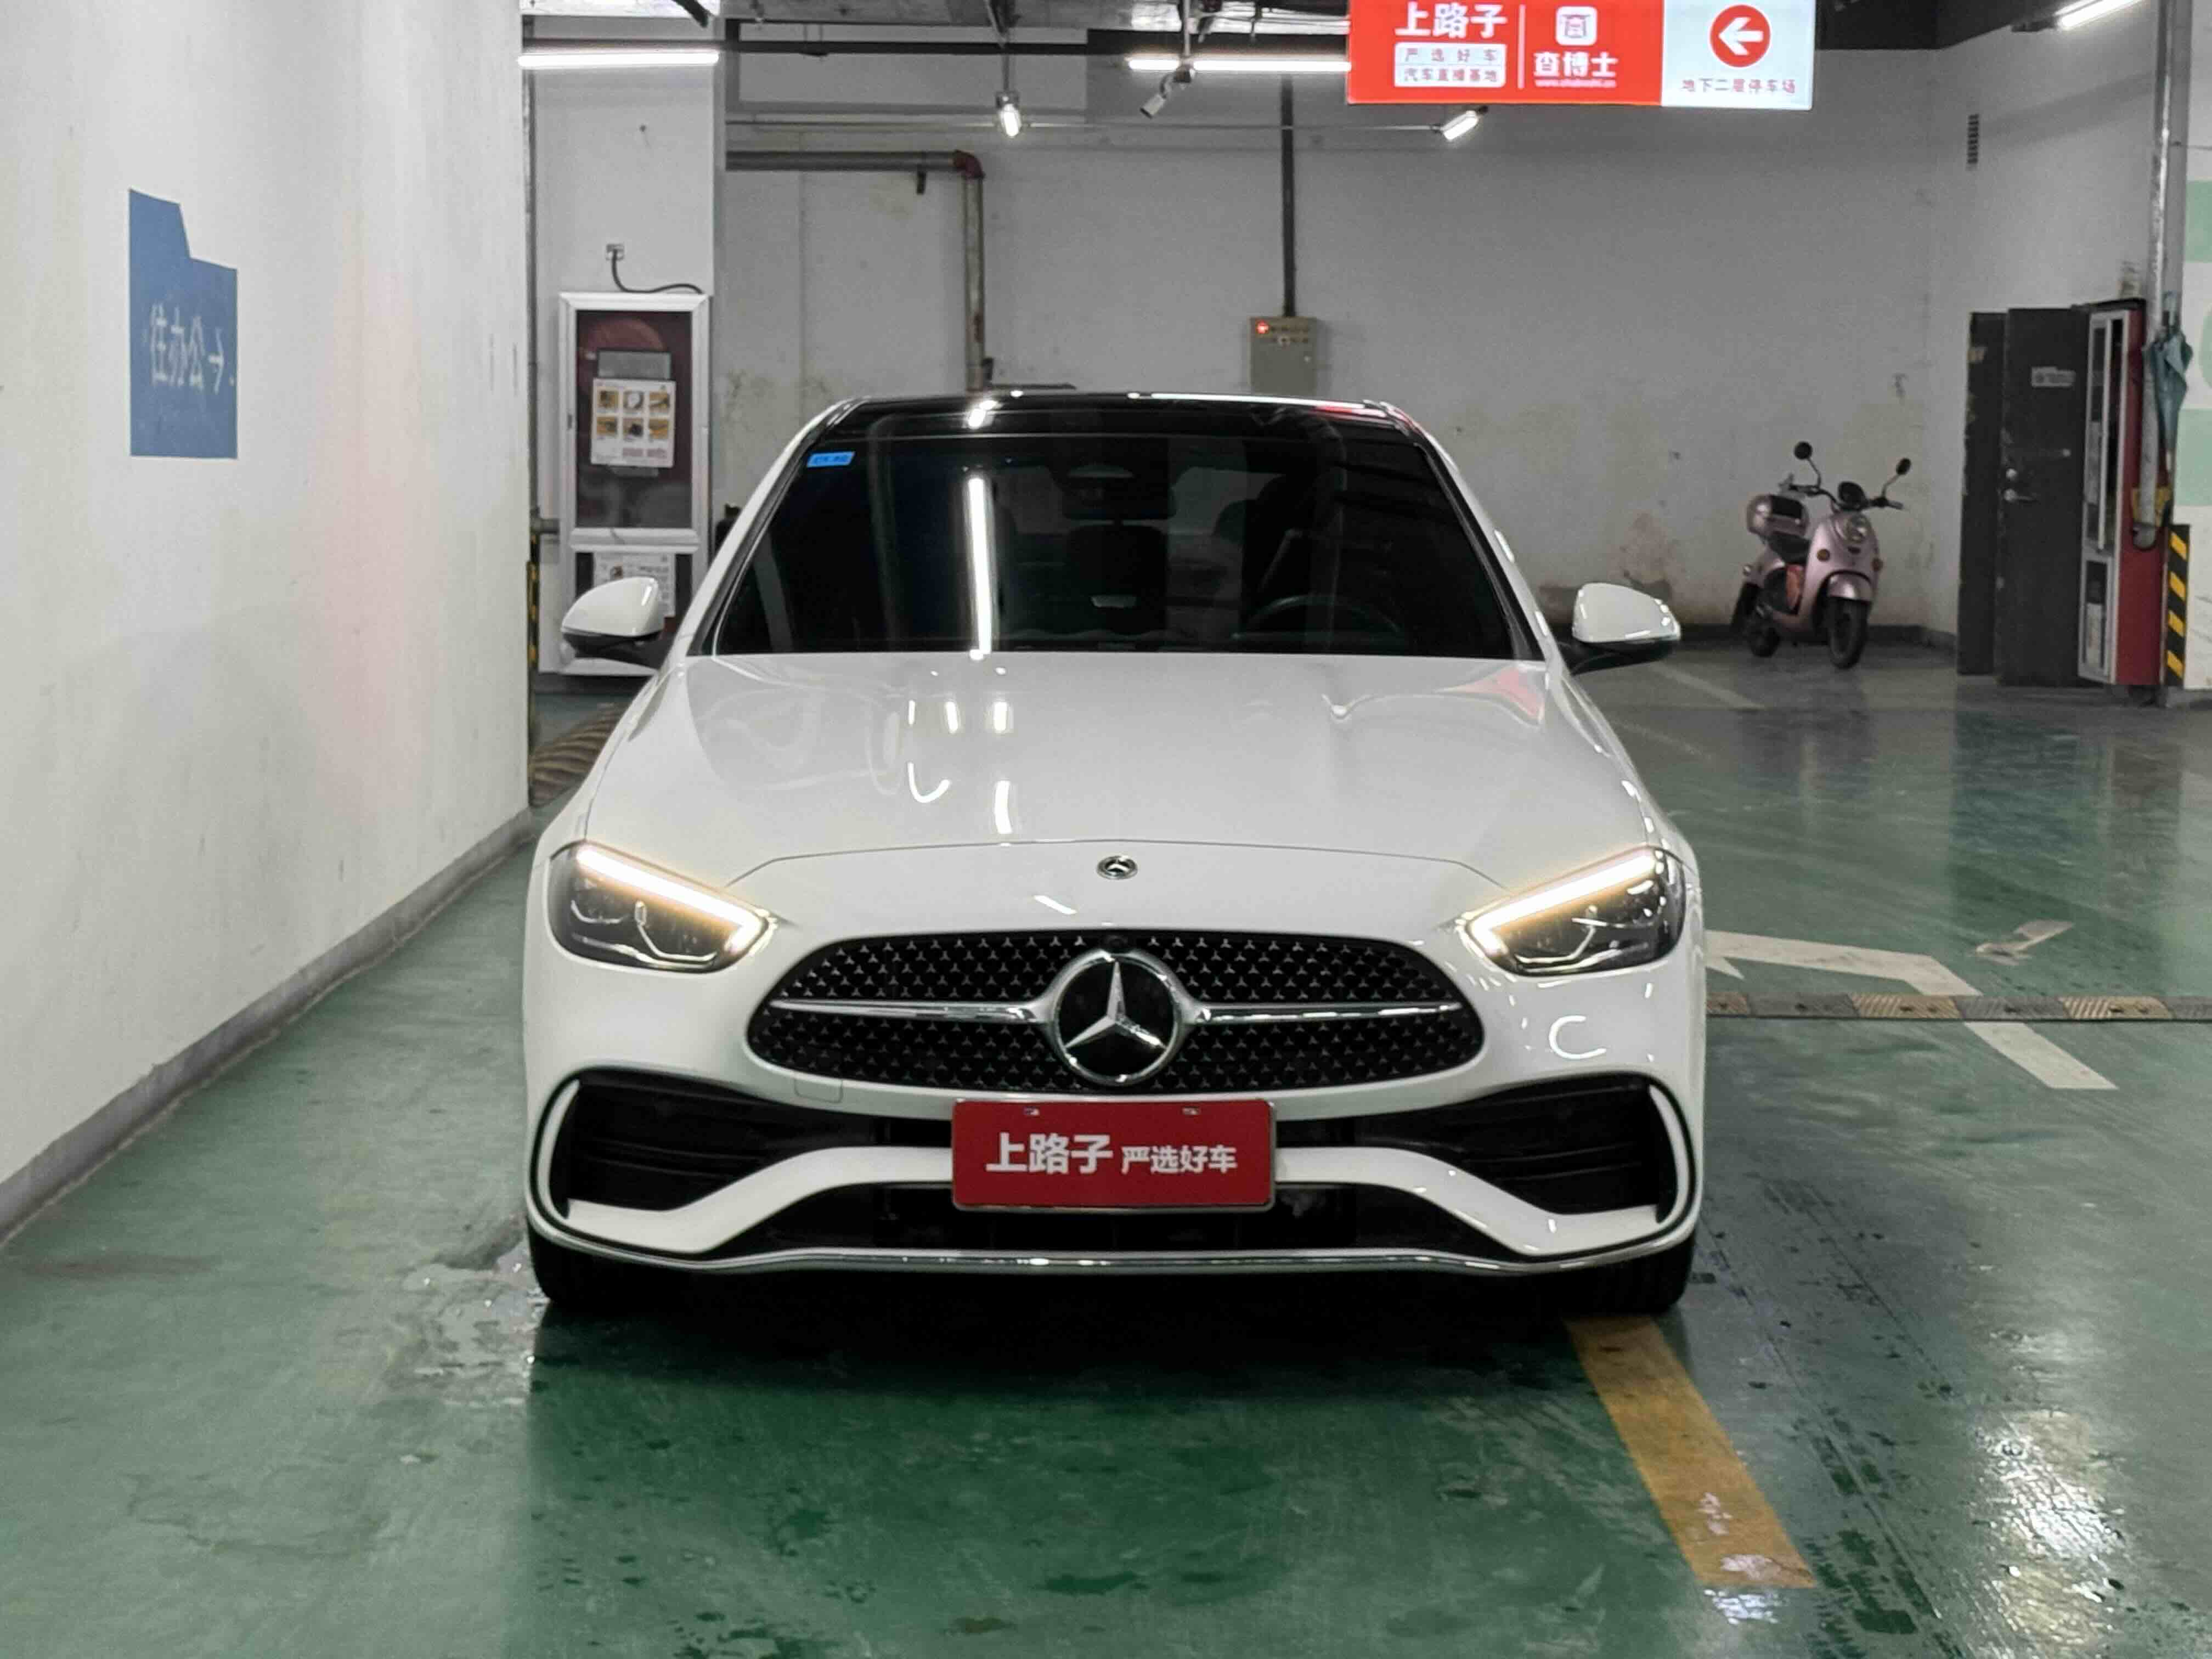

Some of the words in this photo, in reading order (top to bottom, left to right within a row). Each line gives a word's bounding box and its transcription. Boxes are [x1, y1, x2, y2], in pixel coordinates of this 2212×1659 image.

[1394, 1, 1508, 38] 上路子
[1405, 47, 1497, 63] 严选好车
[1533, 51, 1618, 77] 查博士
[986, 1132, 1113, 1174] 上路子
[1121, 1145, 1237, 1174] 严选好车
